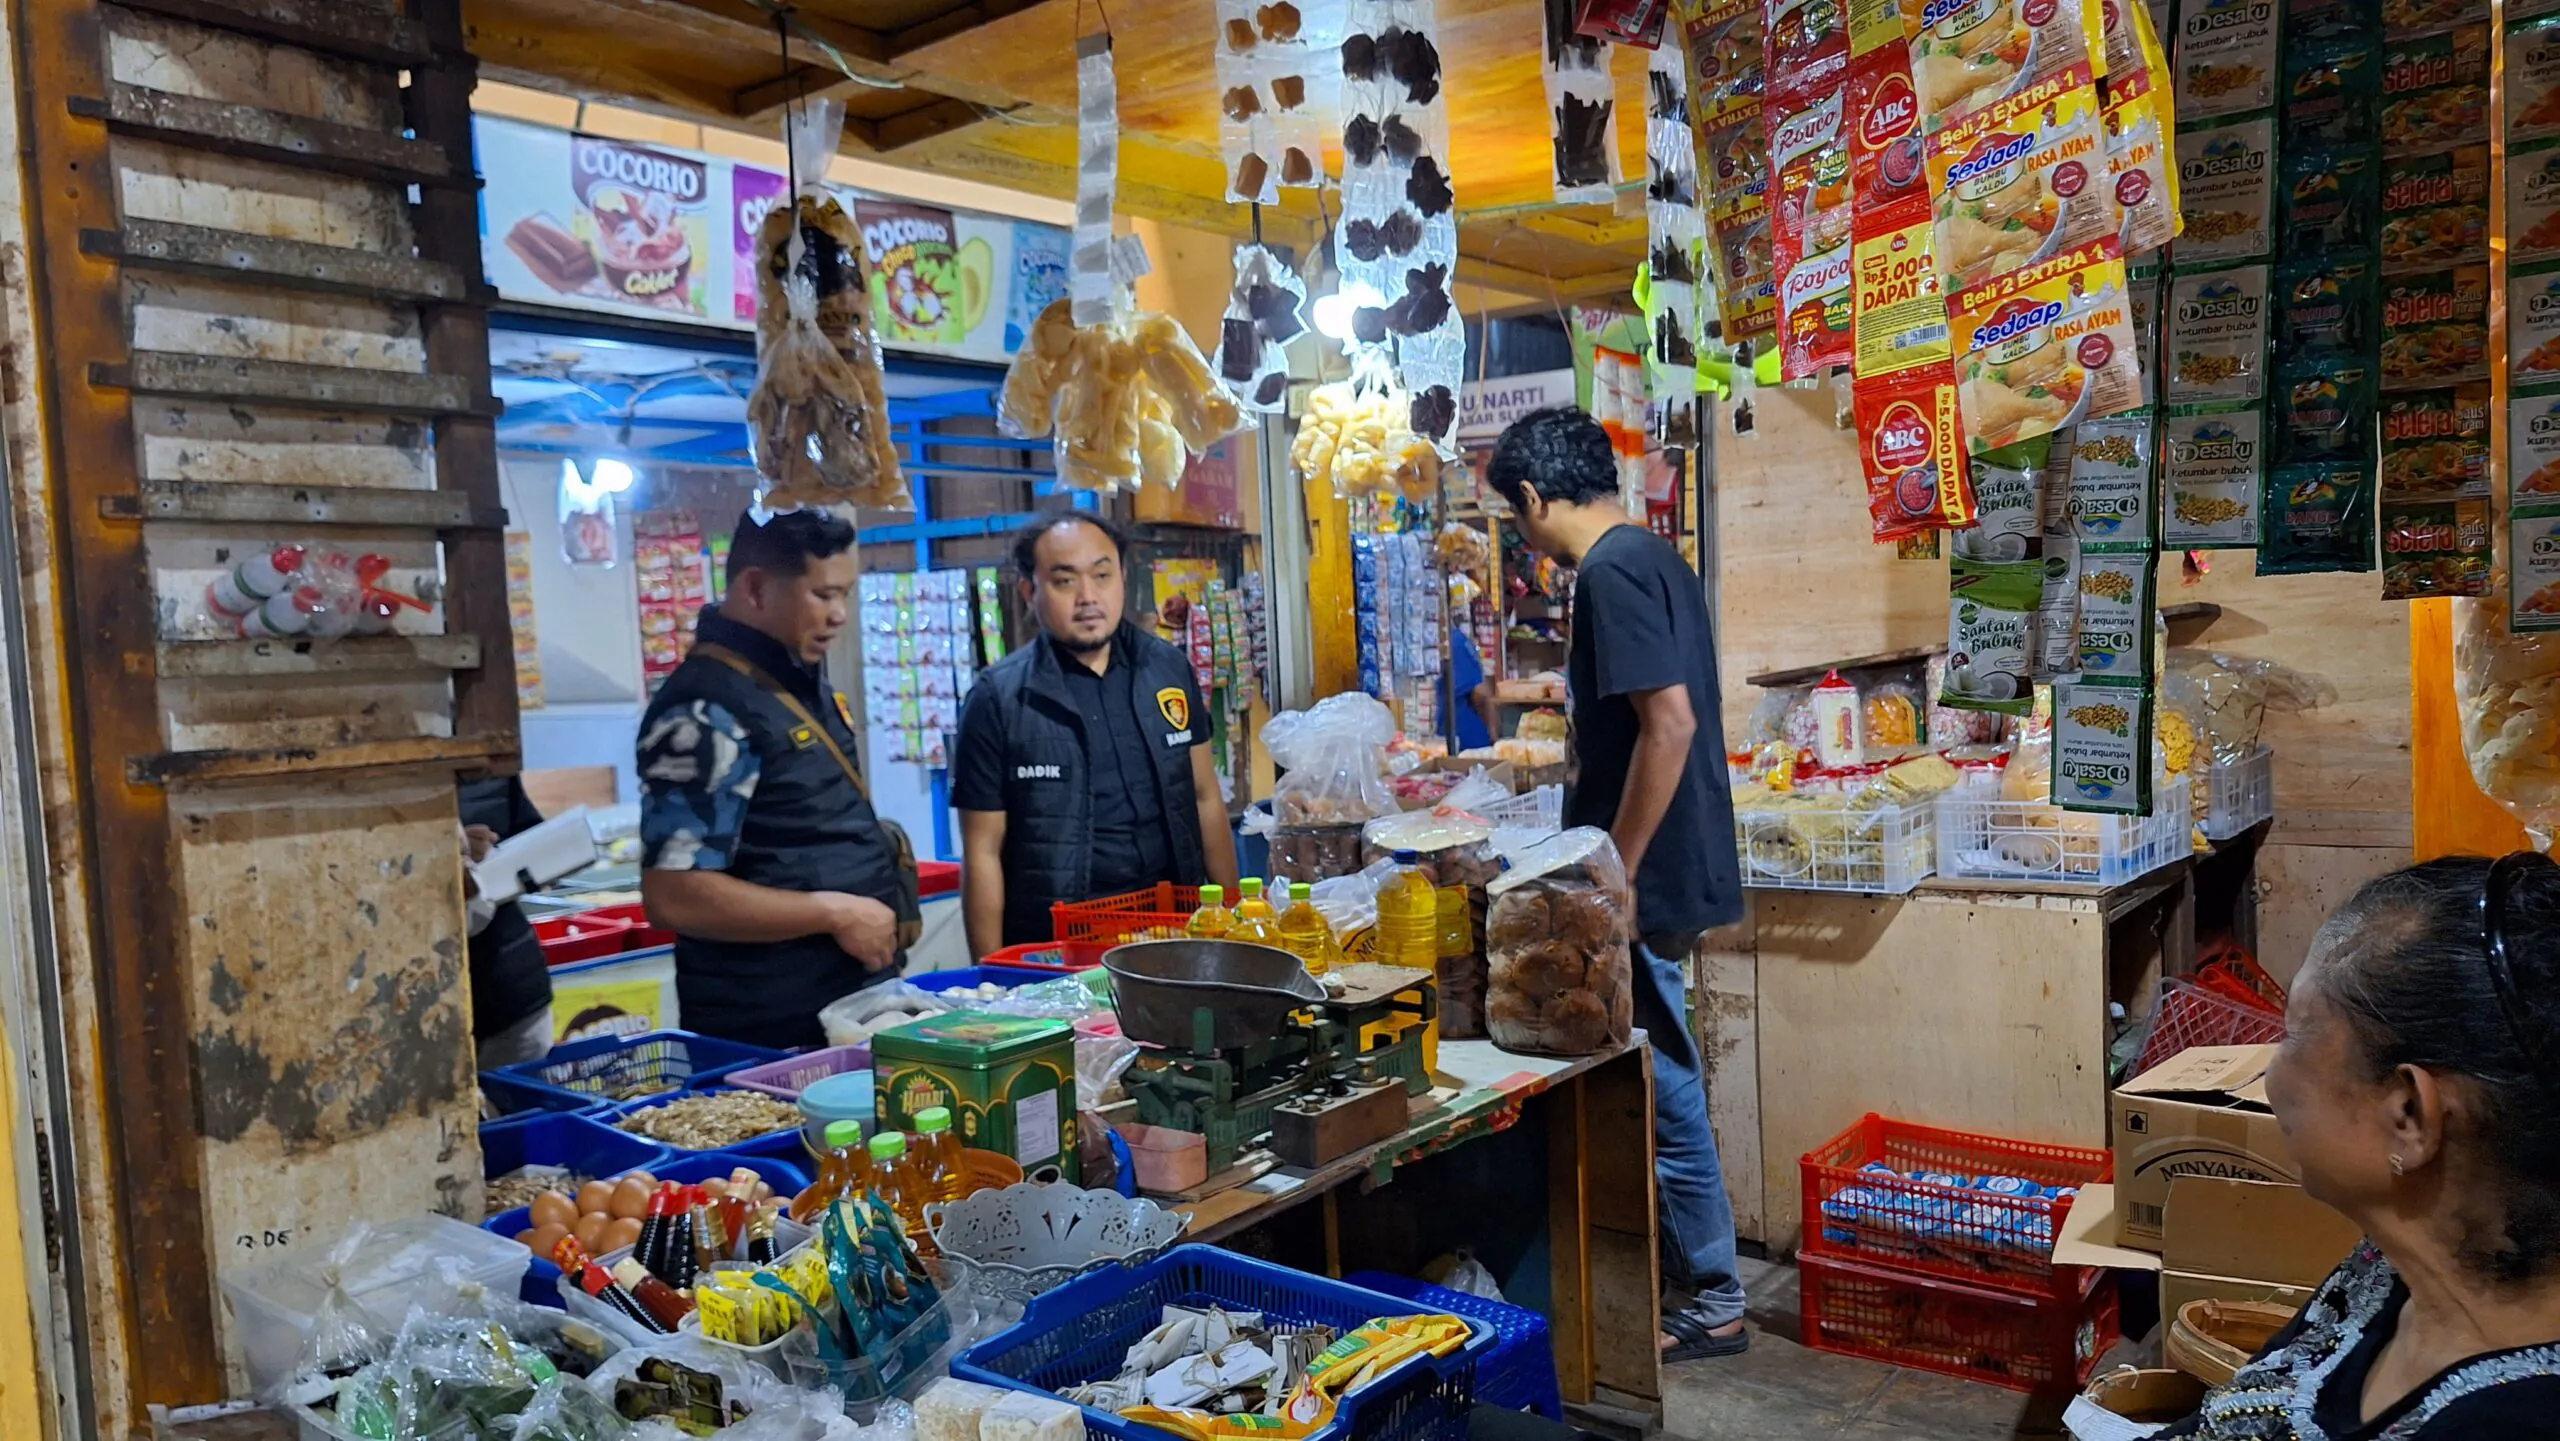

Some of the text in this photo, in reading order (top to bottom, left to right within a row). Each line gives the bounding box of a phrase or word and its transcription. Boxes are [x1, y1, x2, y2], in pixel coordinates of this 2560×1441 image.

[1702, 3, 1746, 28] EXTRA
[1953, 11, 1984, 32] KALDU
[2187, 2, 2270, 37] Desaku
[2184, 34, 2233, 51] ketumbar
[2235, 27, 2269, 42] bubuk
[2126, 79, 2137, 97] 1
[1718, 103, 1761, 127] EXTRA
[1869, 96, 1912, 130] ABC
[1940, 70, 2075, 148] Beli 2 EXTRA 1
[1779, 111, 1836, 149] Royco
[1946, 132, 2036, 188] Sedaap
[2027, 134, 2095, 173] RASA AYAM
[579, 144, 700, 198] COCORIO
[1974, 165, 2008, 187] BUMBU
[2183, 151, 2264, 182] Desaku
[1975, 177, 2007, 197] KALDU
[2180, 182, 2227, 196] ketumbar
[2231, 174, 2264, 190] bubuk
[863, 219, 949, 264] COCORIO
[1787, 258, 1848, 299] Royco
[1962, 243, 2105, 310] Beli 2 EXTRA 1
[1863, 277, 1920, 312] DAPAT
[2179, 294, 2259, 324] Desaku
[1971, 301, 2063, 350] Sedaap
[2055, 308, 2122, 341] RASA AYAM
[2226, 319, 2259, 332] bubuk
[2001, 332, 2030, 351] BUMBU
[2001, 343, 2031, 361] KALDU
[1483, 384, 1545, 410] NARTI
[1881, 427, 1924, 452] ABC
[2173, 436, 2254, 464] Desaku
[1940, 457, 1958, 507] DAPAT
[2220, 464, 2252, 475] bubuk
[1976, 478, 2026, 499] antan
[2098, 482, 2142, 492] ketumbar
[1978, 493, 2034, 516] Bubuk
[2069, 496, 2139, 521] Desaku
[1960, 619, 2016, 642] Santan
[2087, 617, 2134, 628] ketumbar
[1970, 632, 2025, 656] Bubuk
[2080, 632, 2133, 653] Desa
[2063, 747, 2131, 761] ketumbar bubuk
[1017, 764, 1061, 779] DADIK
[2063, 759, 2130, 787] Desaku
